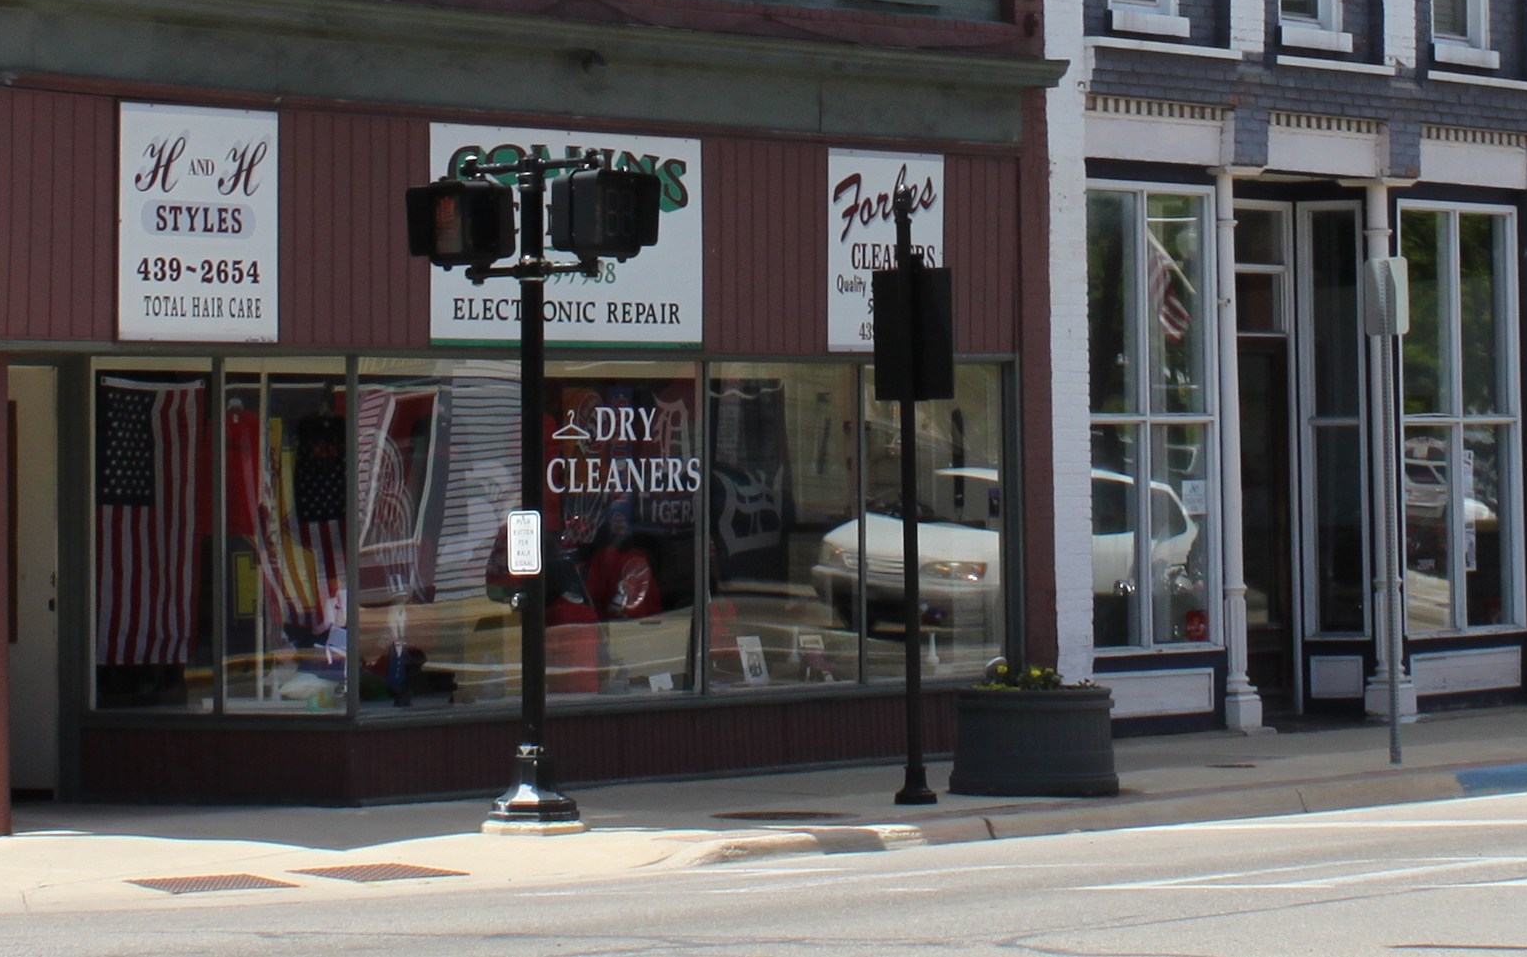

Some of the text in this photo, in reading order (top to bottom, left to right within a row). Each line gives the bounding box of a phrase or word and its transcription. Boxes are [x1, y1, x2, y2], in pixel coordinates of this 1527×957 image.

[133, 136, 269, 197] H AND H
[155, 204, 244, 235] STYLES
[851, 242, 936, 270] CLEAS
[836, 274, 867, 298] Quality
[143, 295, 263, 320] TOTAL HAIR CARE
[451, 297, 682, 326] ELECTONIC REPAIR
[594, 406, 657, 442] DRY
[546, 457, 702, 493] CLEANERS
